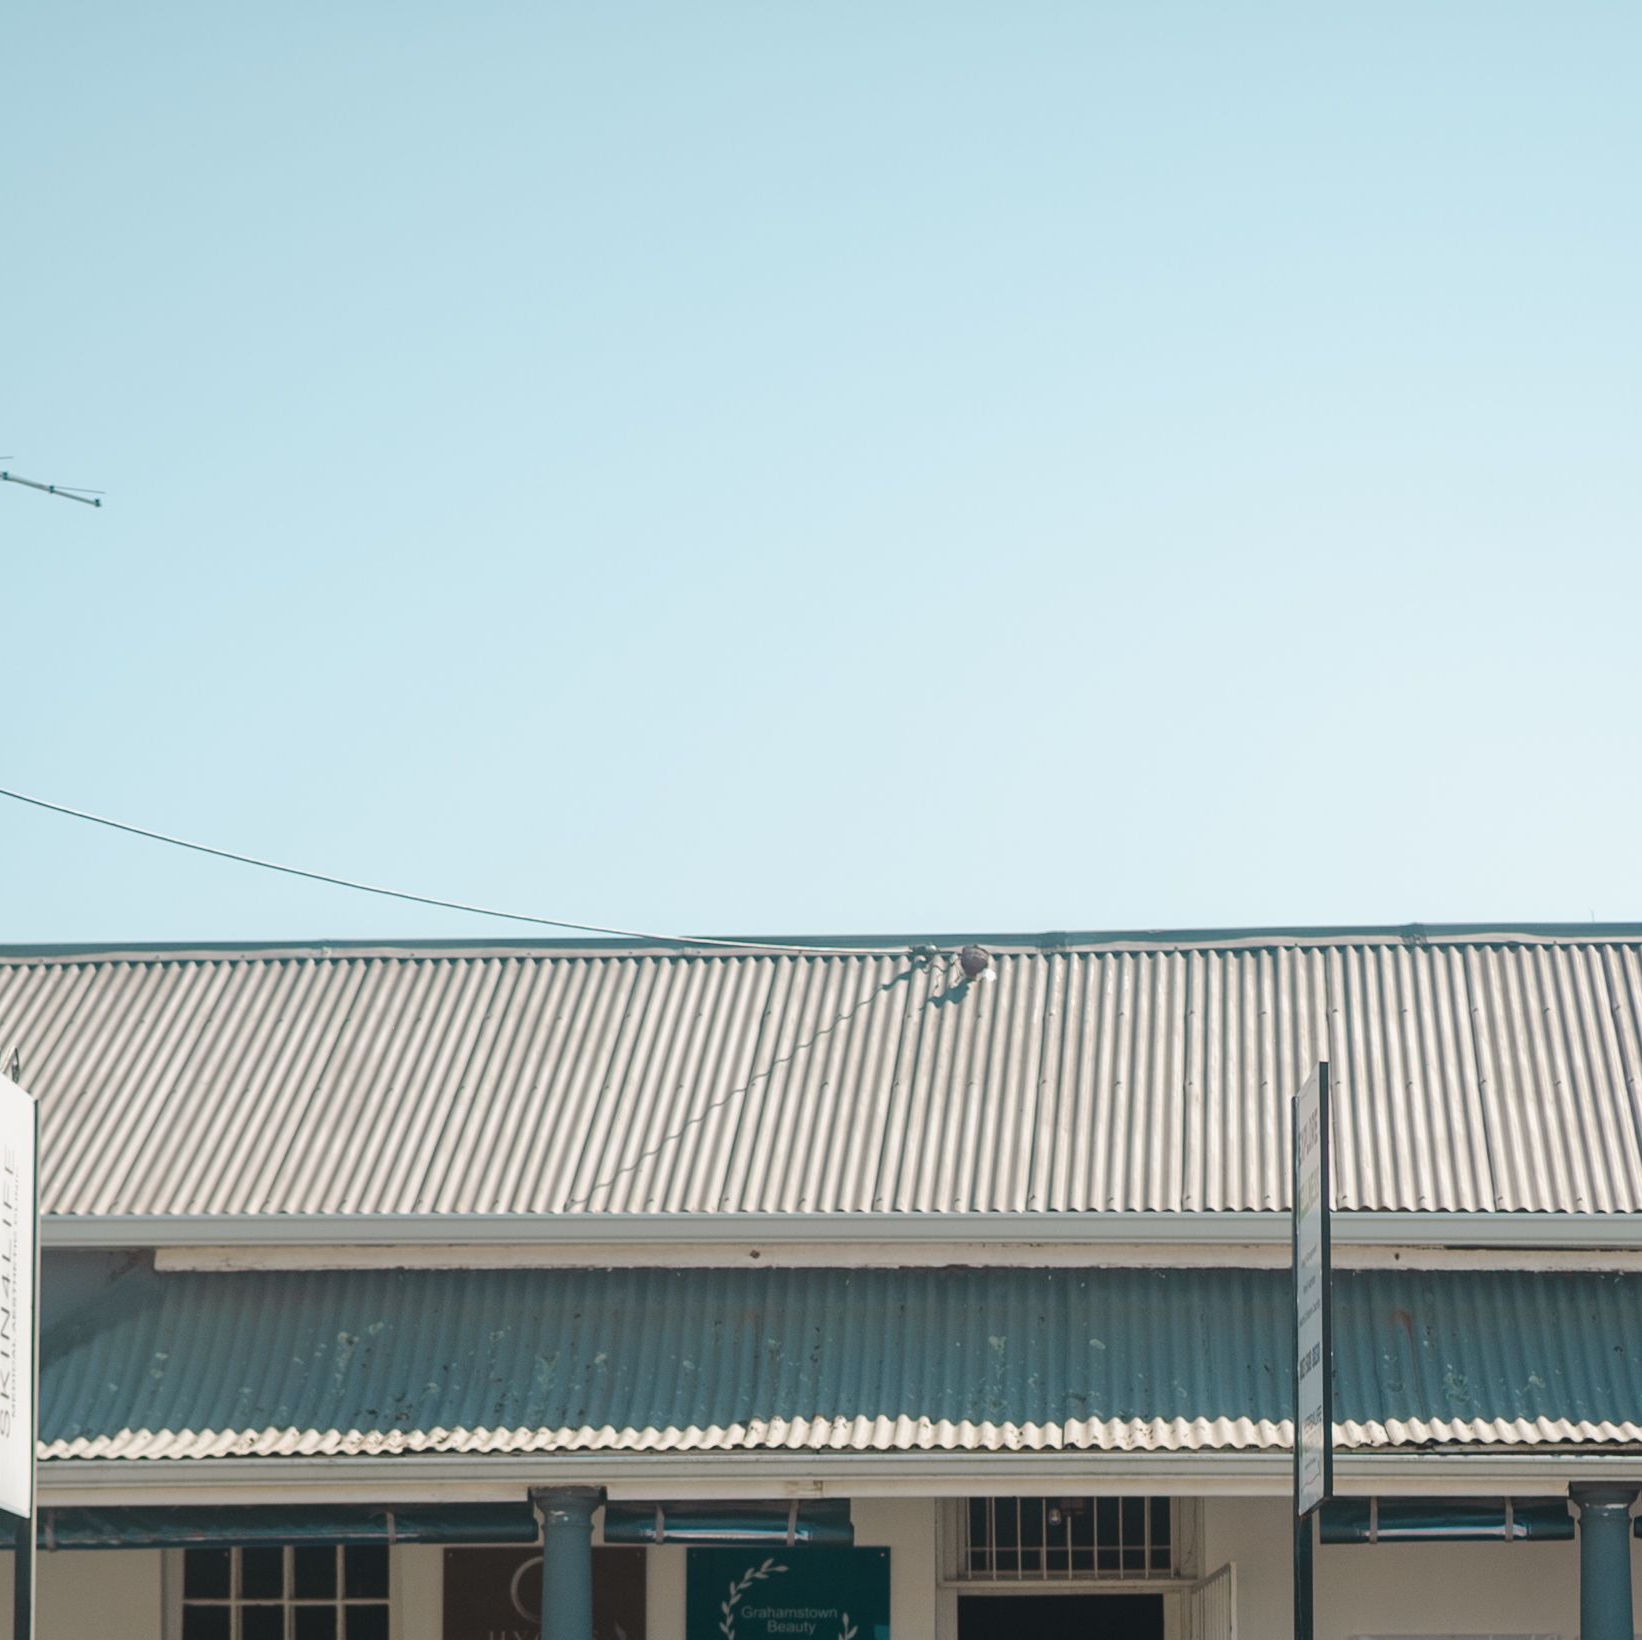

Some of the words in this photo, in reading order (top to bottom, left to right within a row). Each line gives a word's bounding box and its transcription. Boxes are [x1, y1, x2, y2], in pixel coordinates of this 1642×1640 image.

[0, 1145, 14, 1439] SKIN4LIFE
[741, 1605, 837, 1619] Grahamstown
[767, 1620, 816, 1635] Beauty
